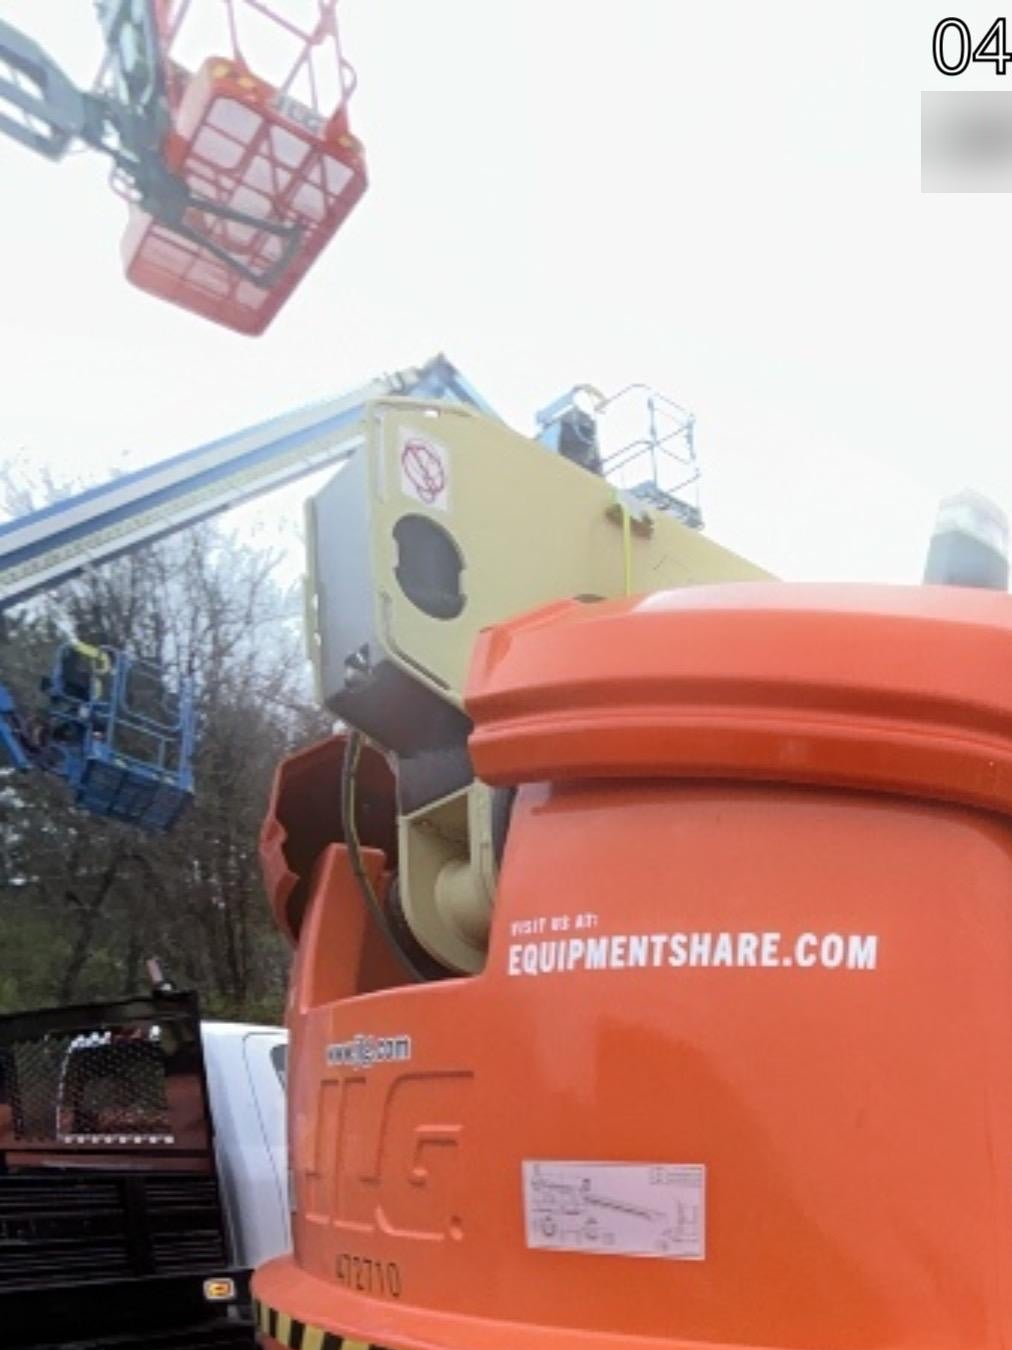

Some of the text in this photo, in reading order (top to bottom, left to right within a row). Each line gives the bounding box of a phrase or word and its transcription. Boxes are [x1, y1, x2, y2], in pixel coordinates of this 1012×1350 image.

[510, 917, 547, 936] VISIT
[551, 915, 571, 931] US
[508, 931, 878, 976] EQUIPMENTSHARE.COM
[336, 1254, 401, 1298] 472710
